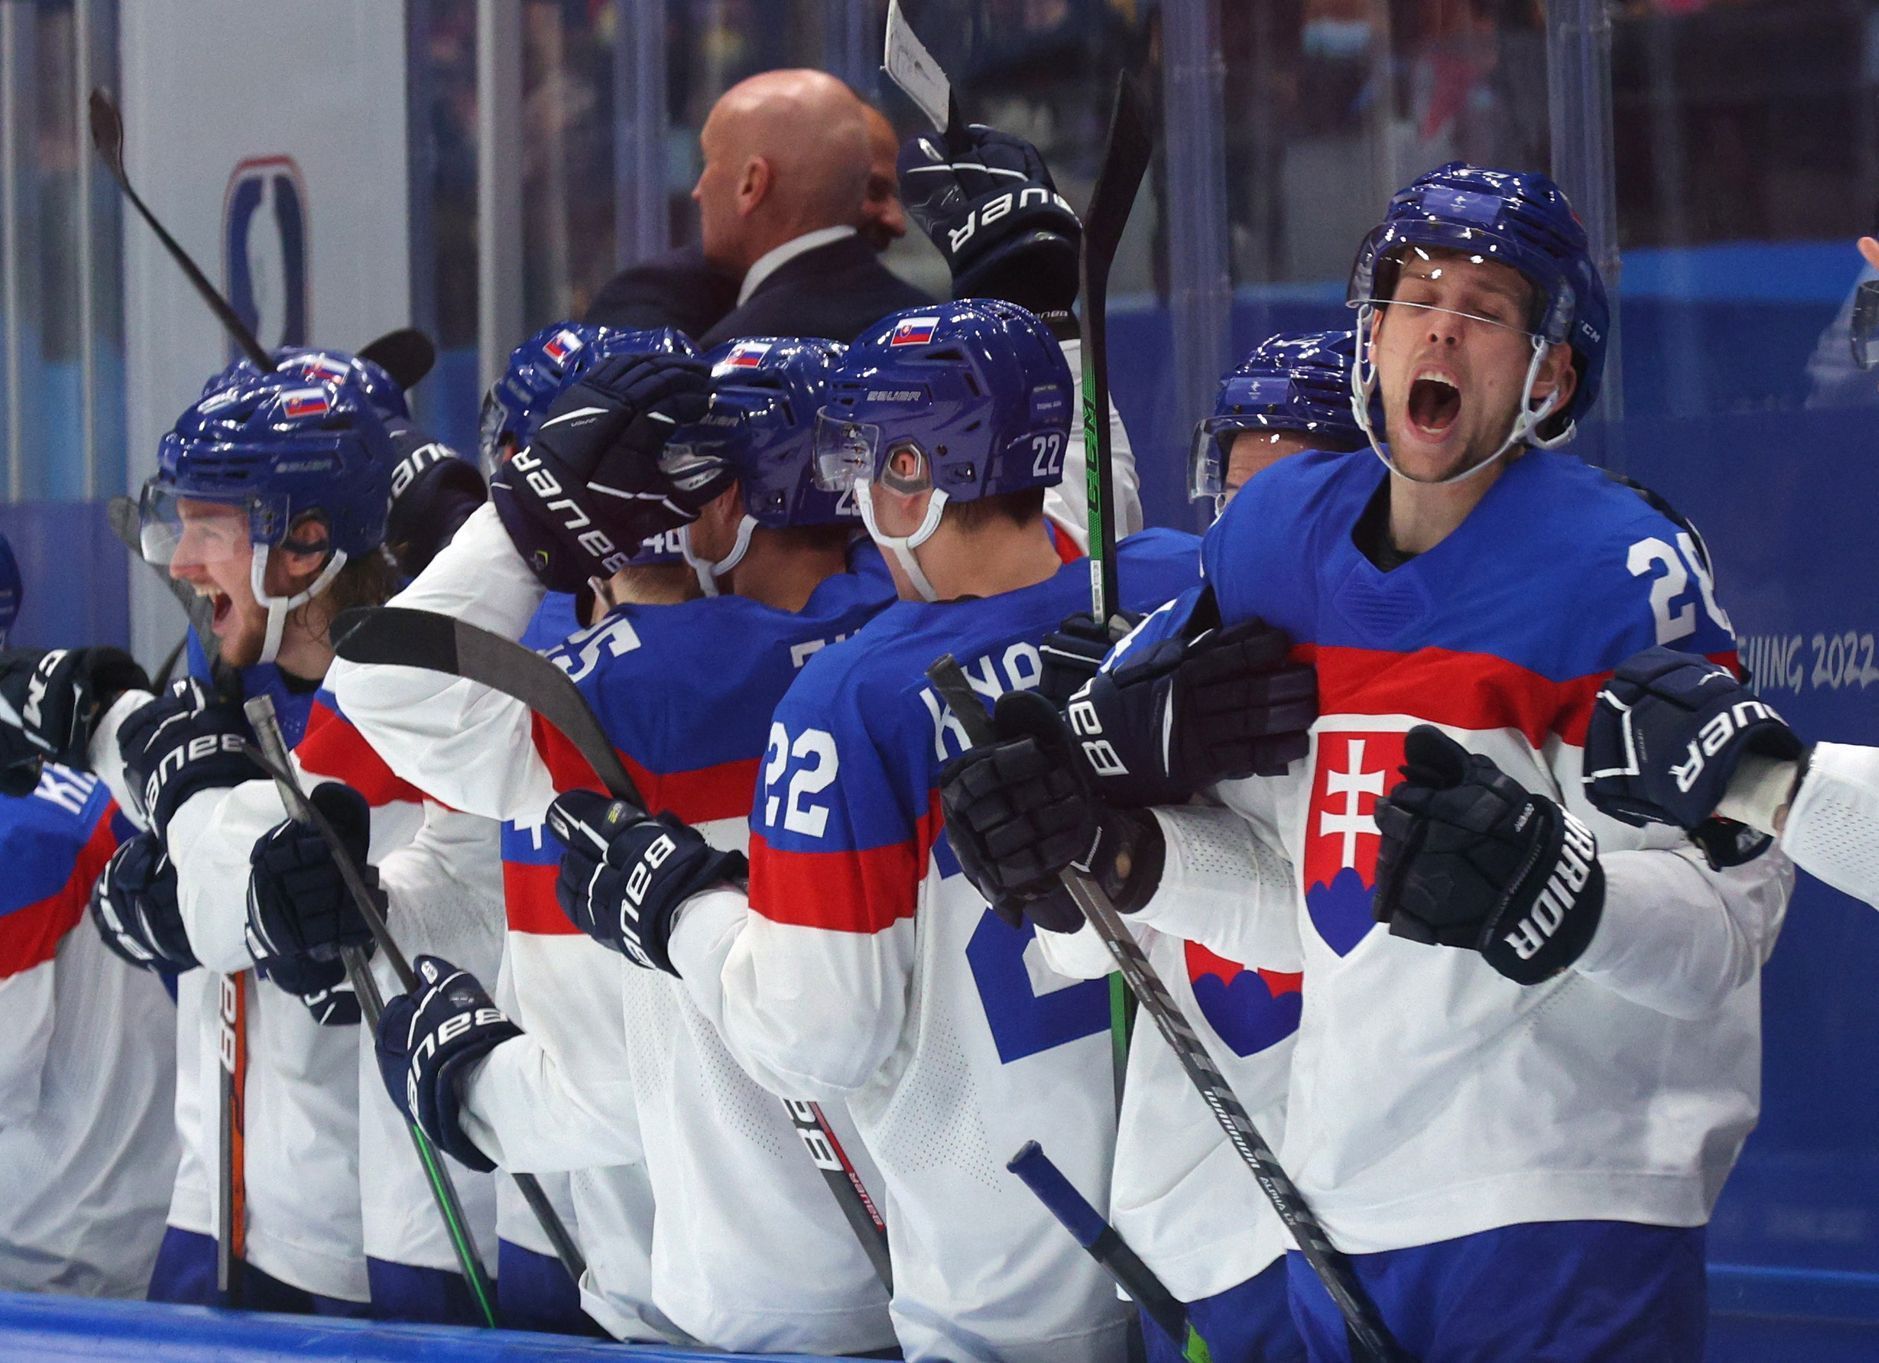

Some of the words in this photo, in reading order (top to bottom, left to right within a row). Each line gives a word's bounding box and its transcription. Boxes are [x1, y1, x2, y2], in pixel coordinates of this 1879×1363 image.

[1032, 434, 1061, 477] 22
[1811, 629, 1879, 690] 2022
[765, 721, 839, 838] 22
